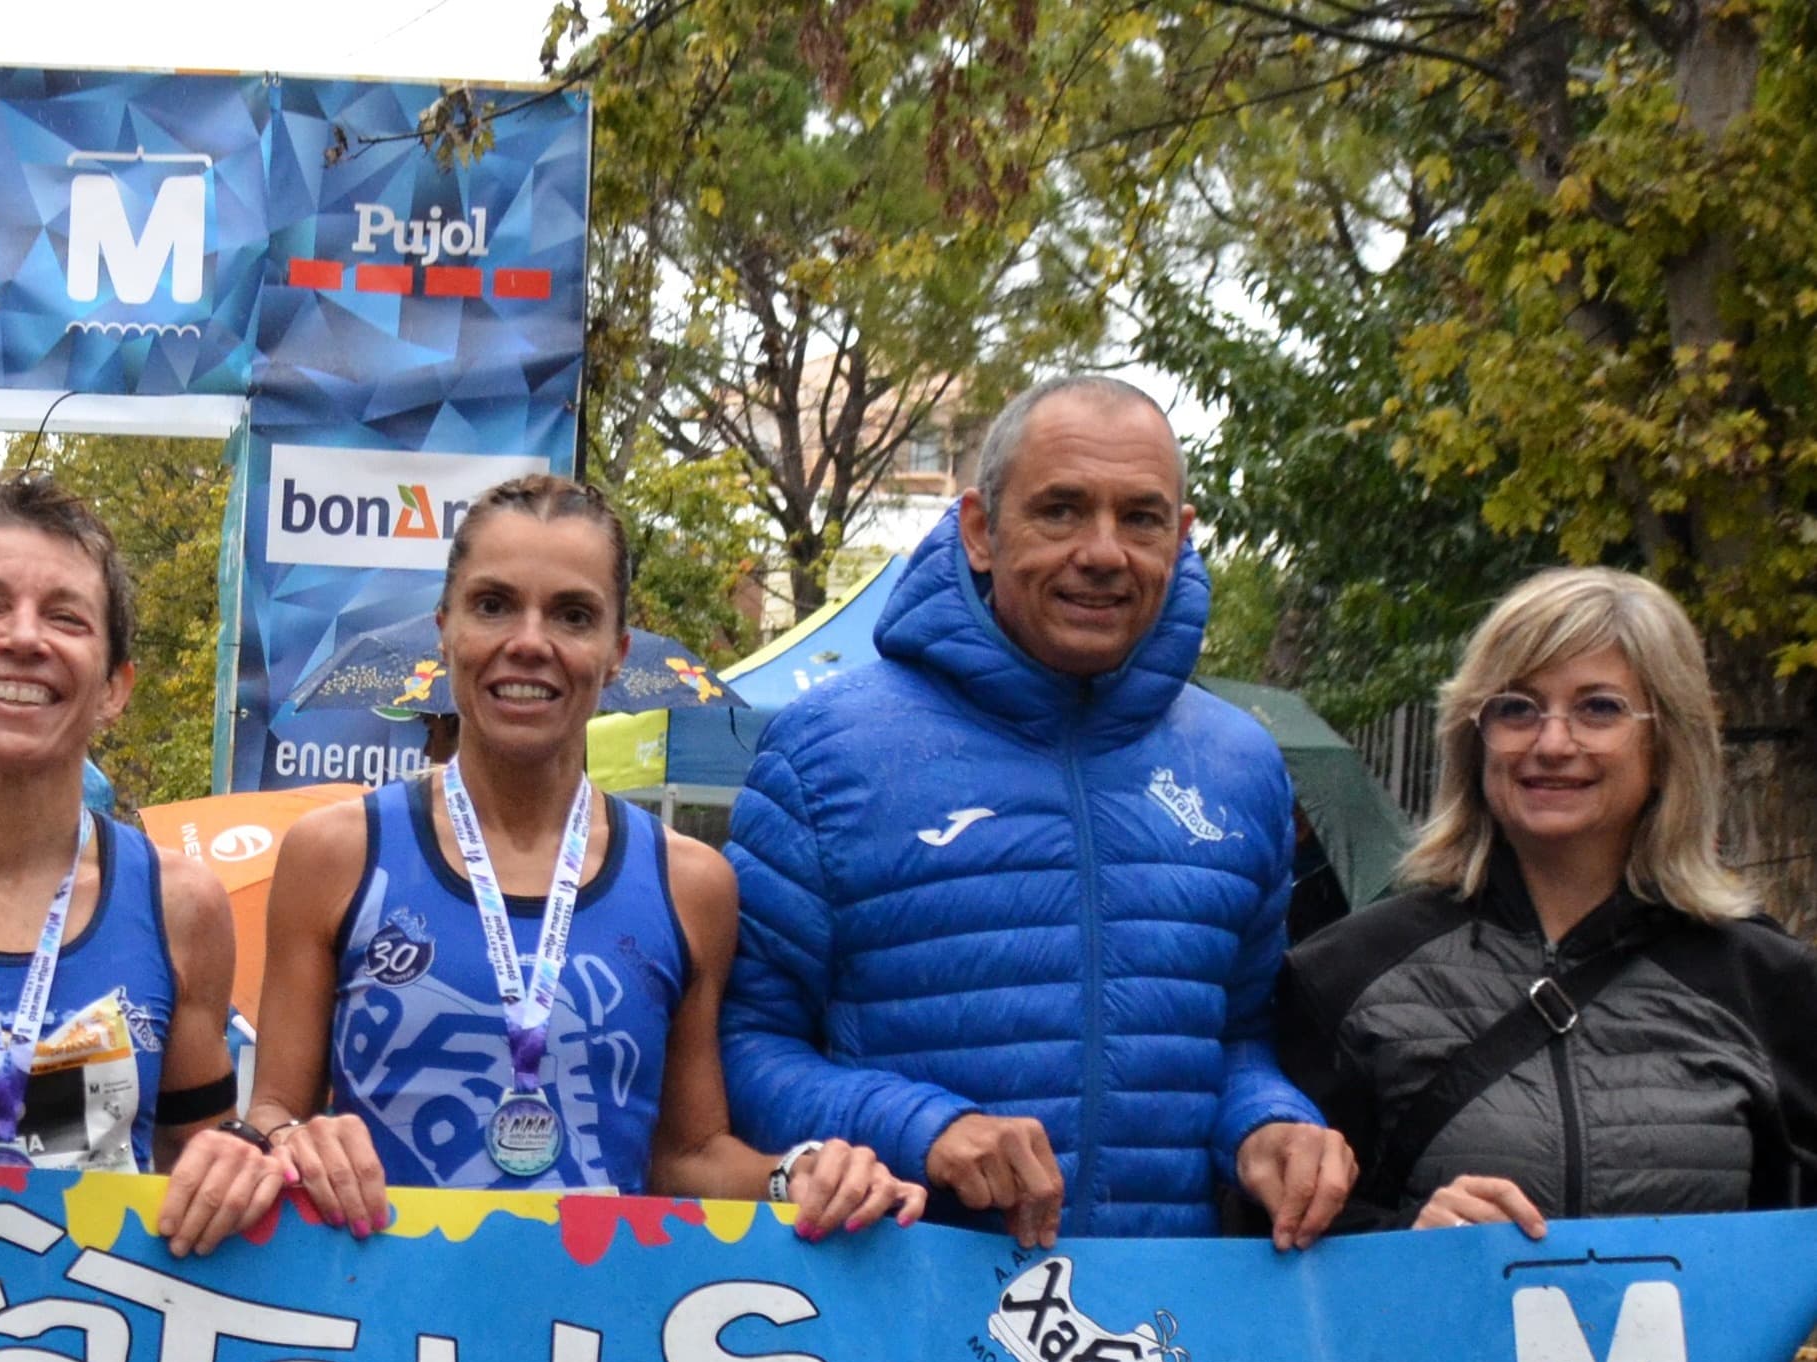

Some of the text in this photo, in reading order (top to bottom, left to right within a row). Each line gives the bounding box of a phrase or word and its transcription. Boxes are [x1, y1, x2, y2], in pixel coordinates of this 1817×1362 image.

[66, 174, 206, 305] M
[351, 202, 489, 266] Pujol
[275, 740, 431, 789] energia
[365, 940, 419, 977] 30
